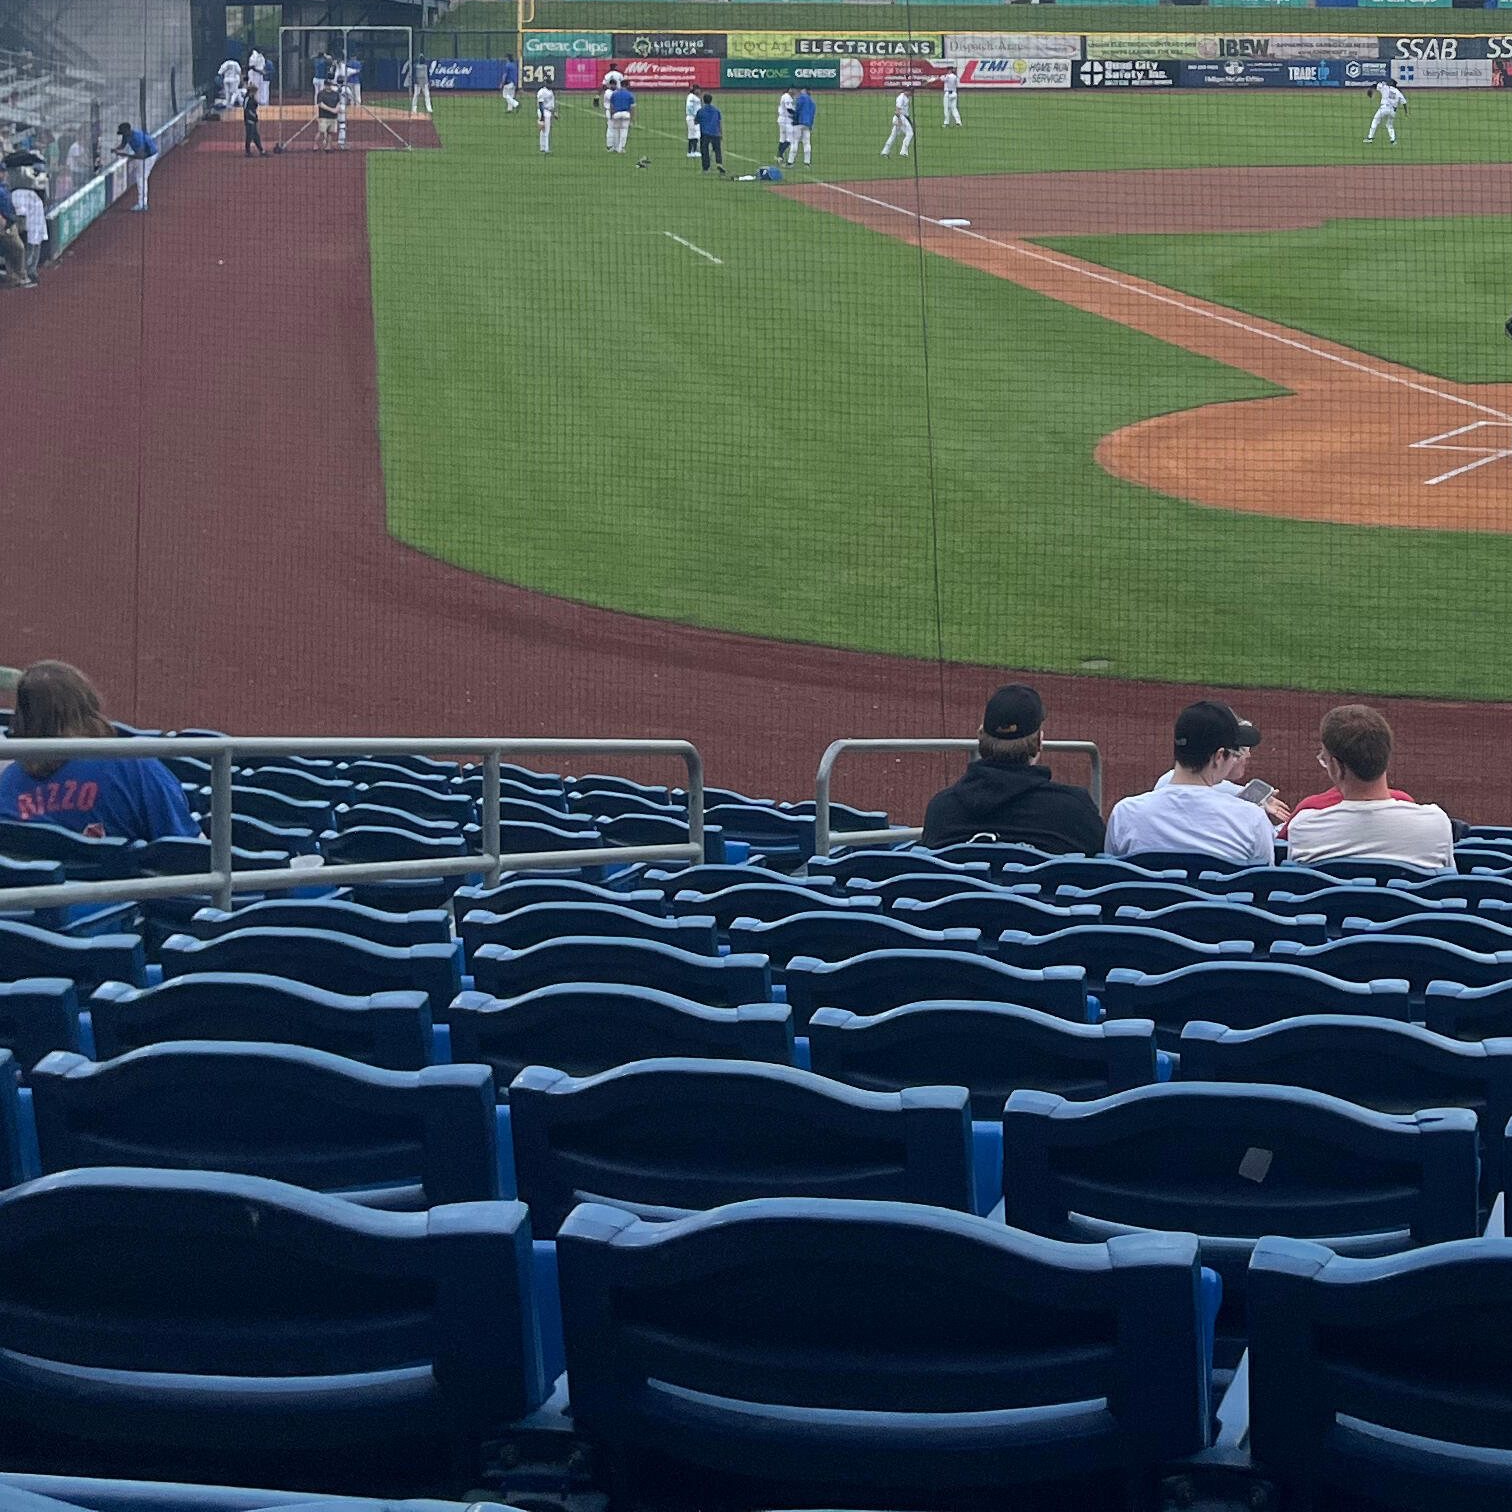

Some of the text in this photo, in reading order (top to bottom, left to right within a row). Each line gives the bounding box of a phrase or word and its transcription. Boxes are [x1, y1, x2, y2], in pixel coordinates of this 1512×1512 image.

[526, 38, 609, 55] Great Clips
[653, 39, 704, 48] LIGHTING
[734, 39, 931, 54] LOCAL ELECTRICIANS
[1218, 38, 1270, 57] IBEW
[1395, 38, 1458, 60] SSAB
[979, 60, 1009, 72] TMI
[1029, 62, 1069, 72] HOME RUN
[1104, 60, 1159, 71] Quad City
[523, 65, 555, 83] 343
[795, 68, 837, 79] GENESIS
[1288, 66, 1317, 81] TRADE
[17, 780, 98, 820] RIZZO
